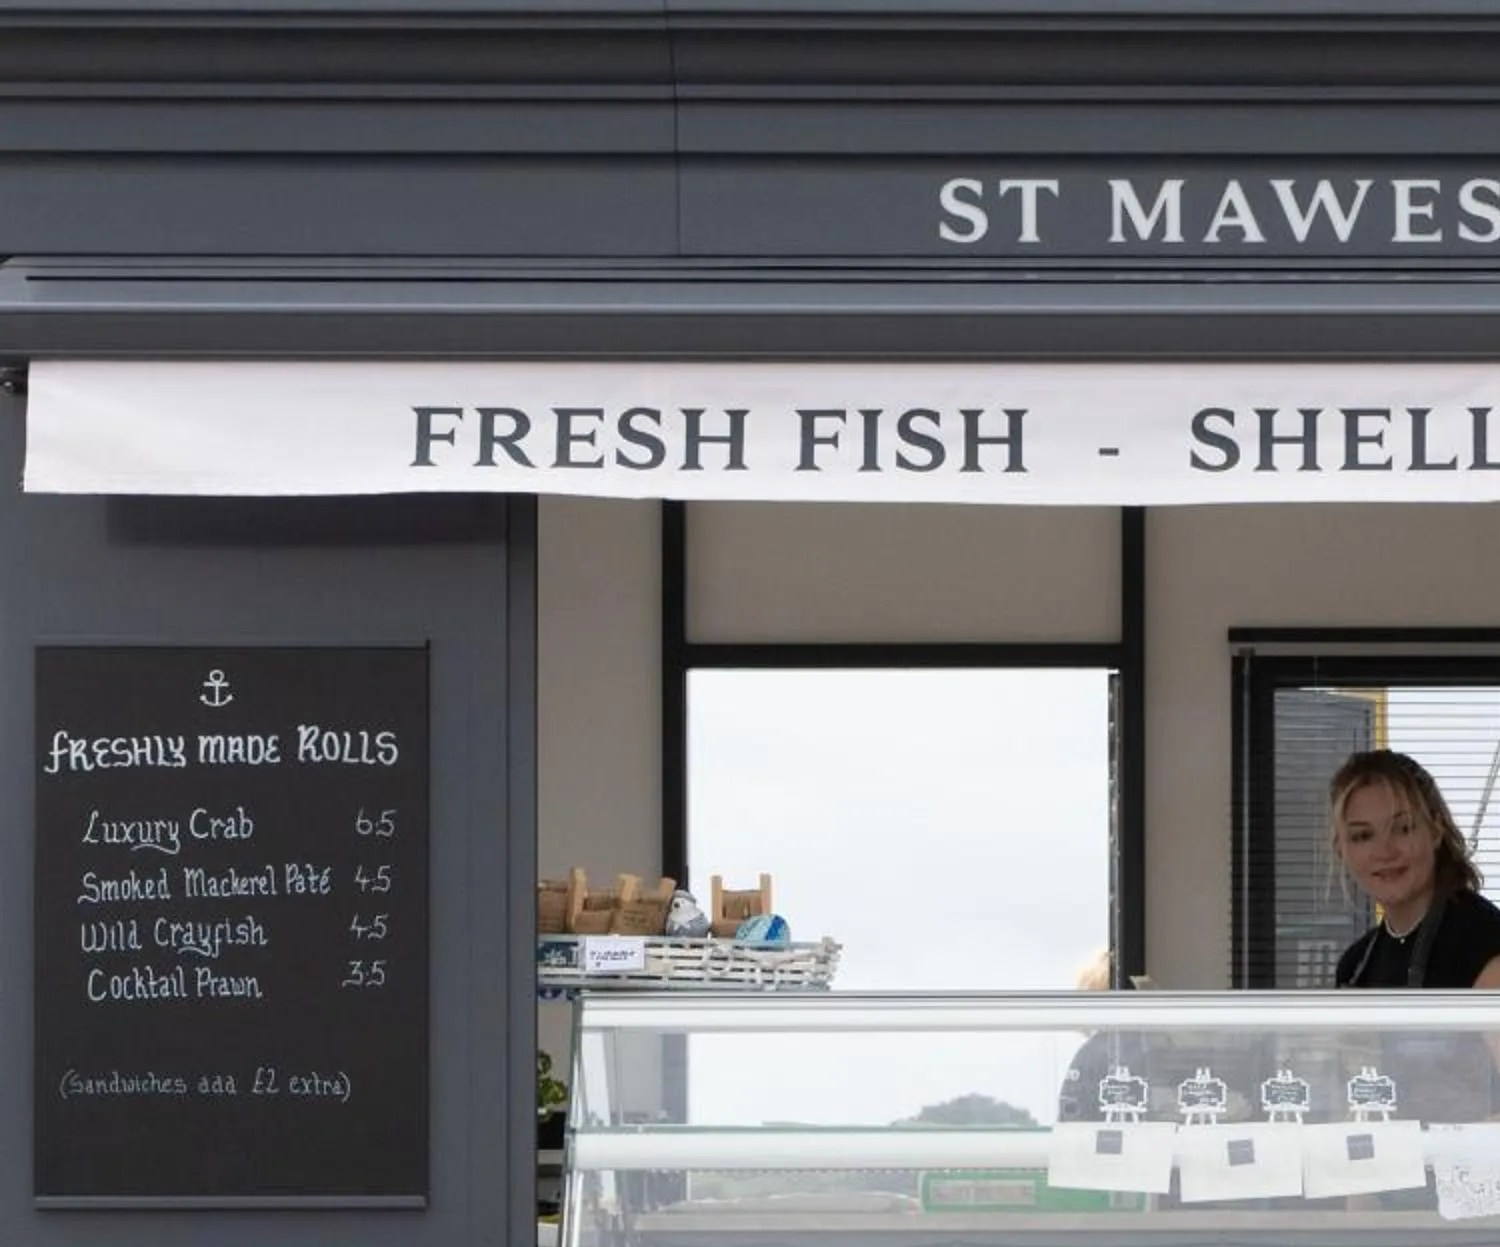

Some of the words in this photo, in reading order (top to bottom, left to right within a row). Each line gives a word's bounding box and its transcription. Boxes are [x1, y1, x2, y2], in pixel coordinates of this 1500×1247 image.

[939, 177, 1060, 244] ST
[410, 406, 751, 471] FRESH
[794, 407, 1029, 473] FISH
[297, 724, 399, 766] ROLLS
[81, 810, 181, 855] Luxury
[189, 806, 254, 839] Crab
[77, 867, 172, 904] Smoked
[183, 864, 278, 898] Mackerel
[81, 919, 143, 953] Wild
[154, 915, 269, 959] Crayfish
[87, 965, 188, 1002] Cocktail
[194, 966, 263, 999] Prawn
[59, 1068, 188, 1099] (Sandwiches
[289, 1071, 351, 1103] extra)
